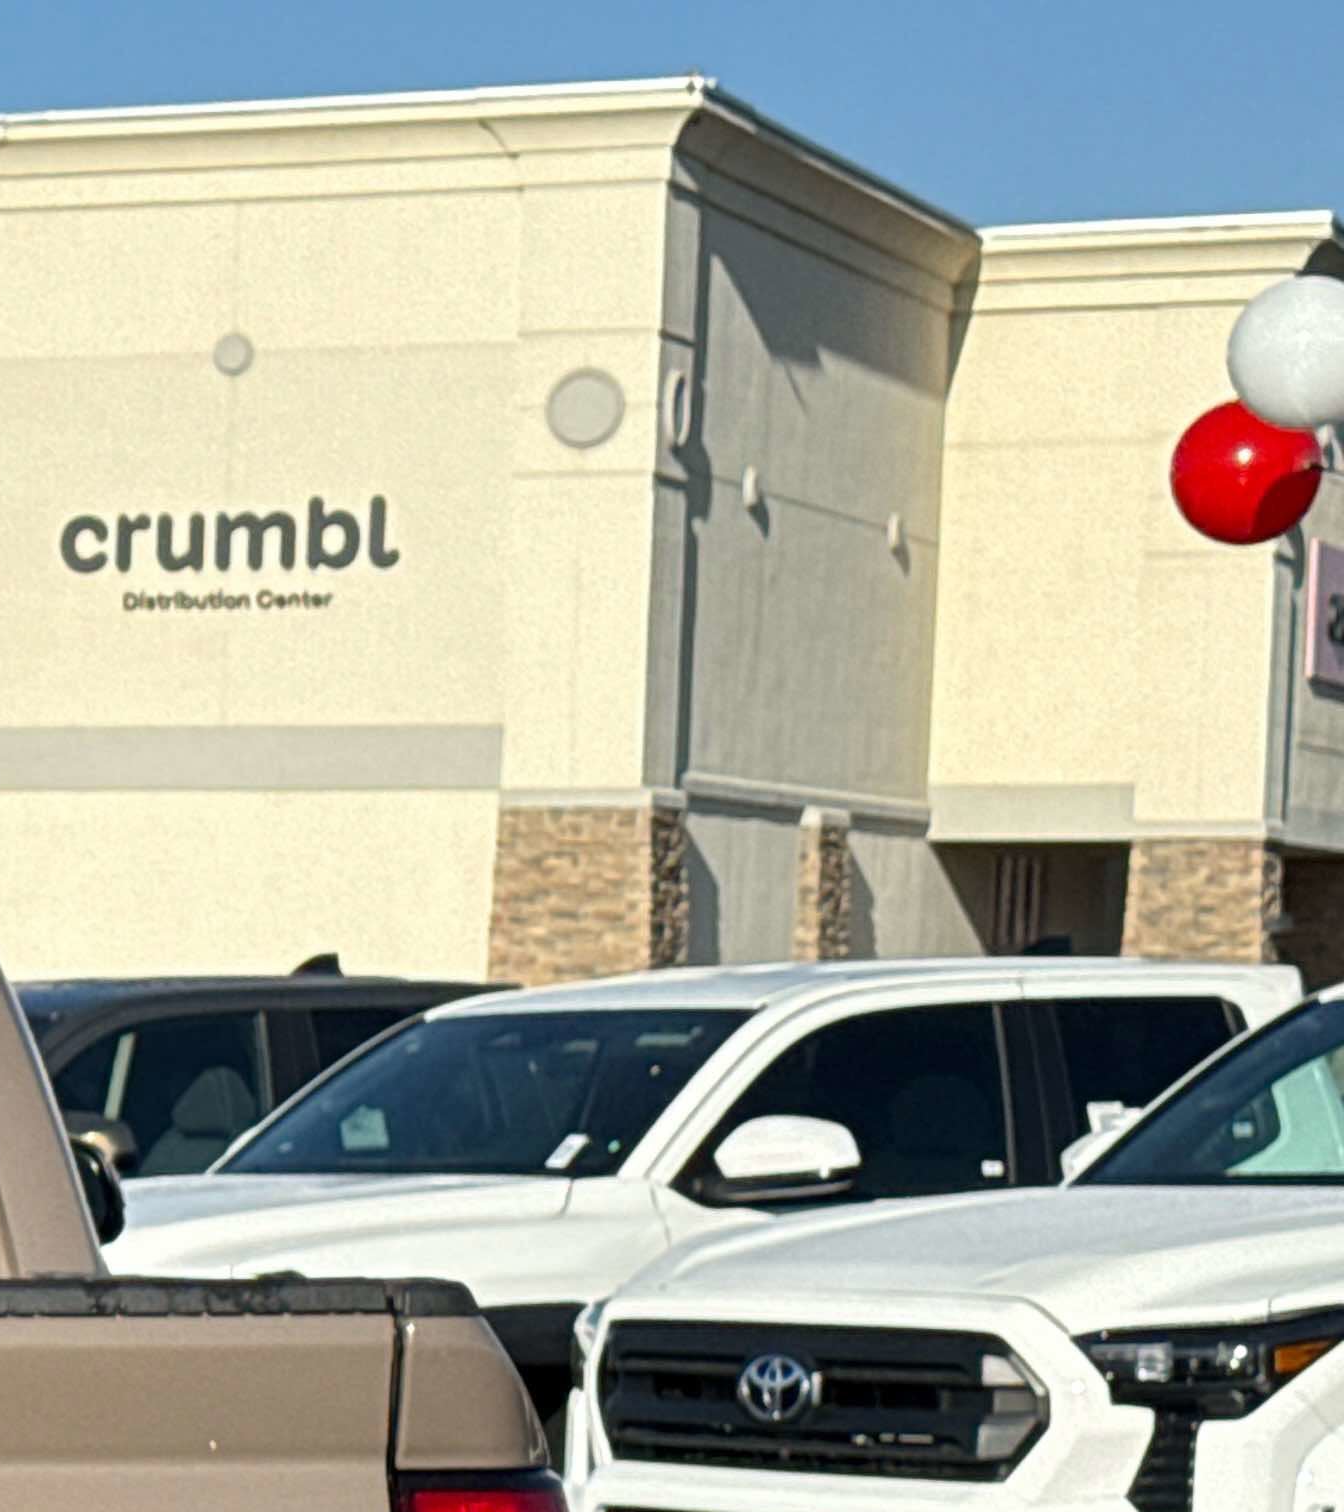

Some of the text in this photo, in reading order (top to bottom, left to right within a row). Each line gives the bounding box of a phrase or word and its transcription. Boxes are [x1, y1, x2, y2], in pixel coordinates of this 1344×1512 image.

[60, 495, 400, 574] crumbl
[122, 588, 334, 612] Distribution Center
